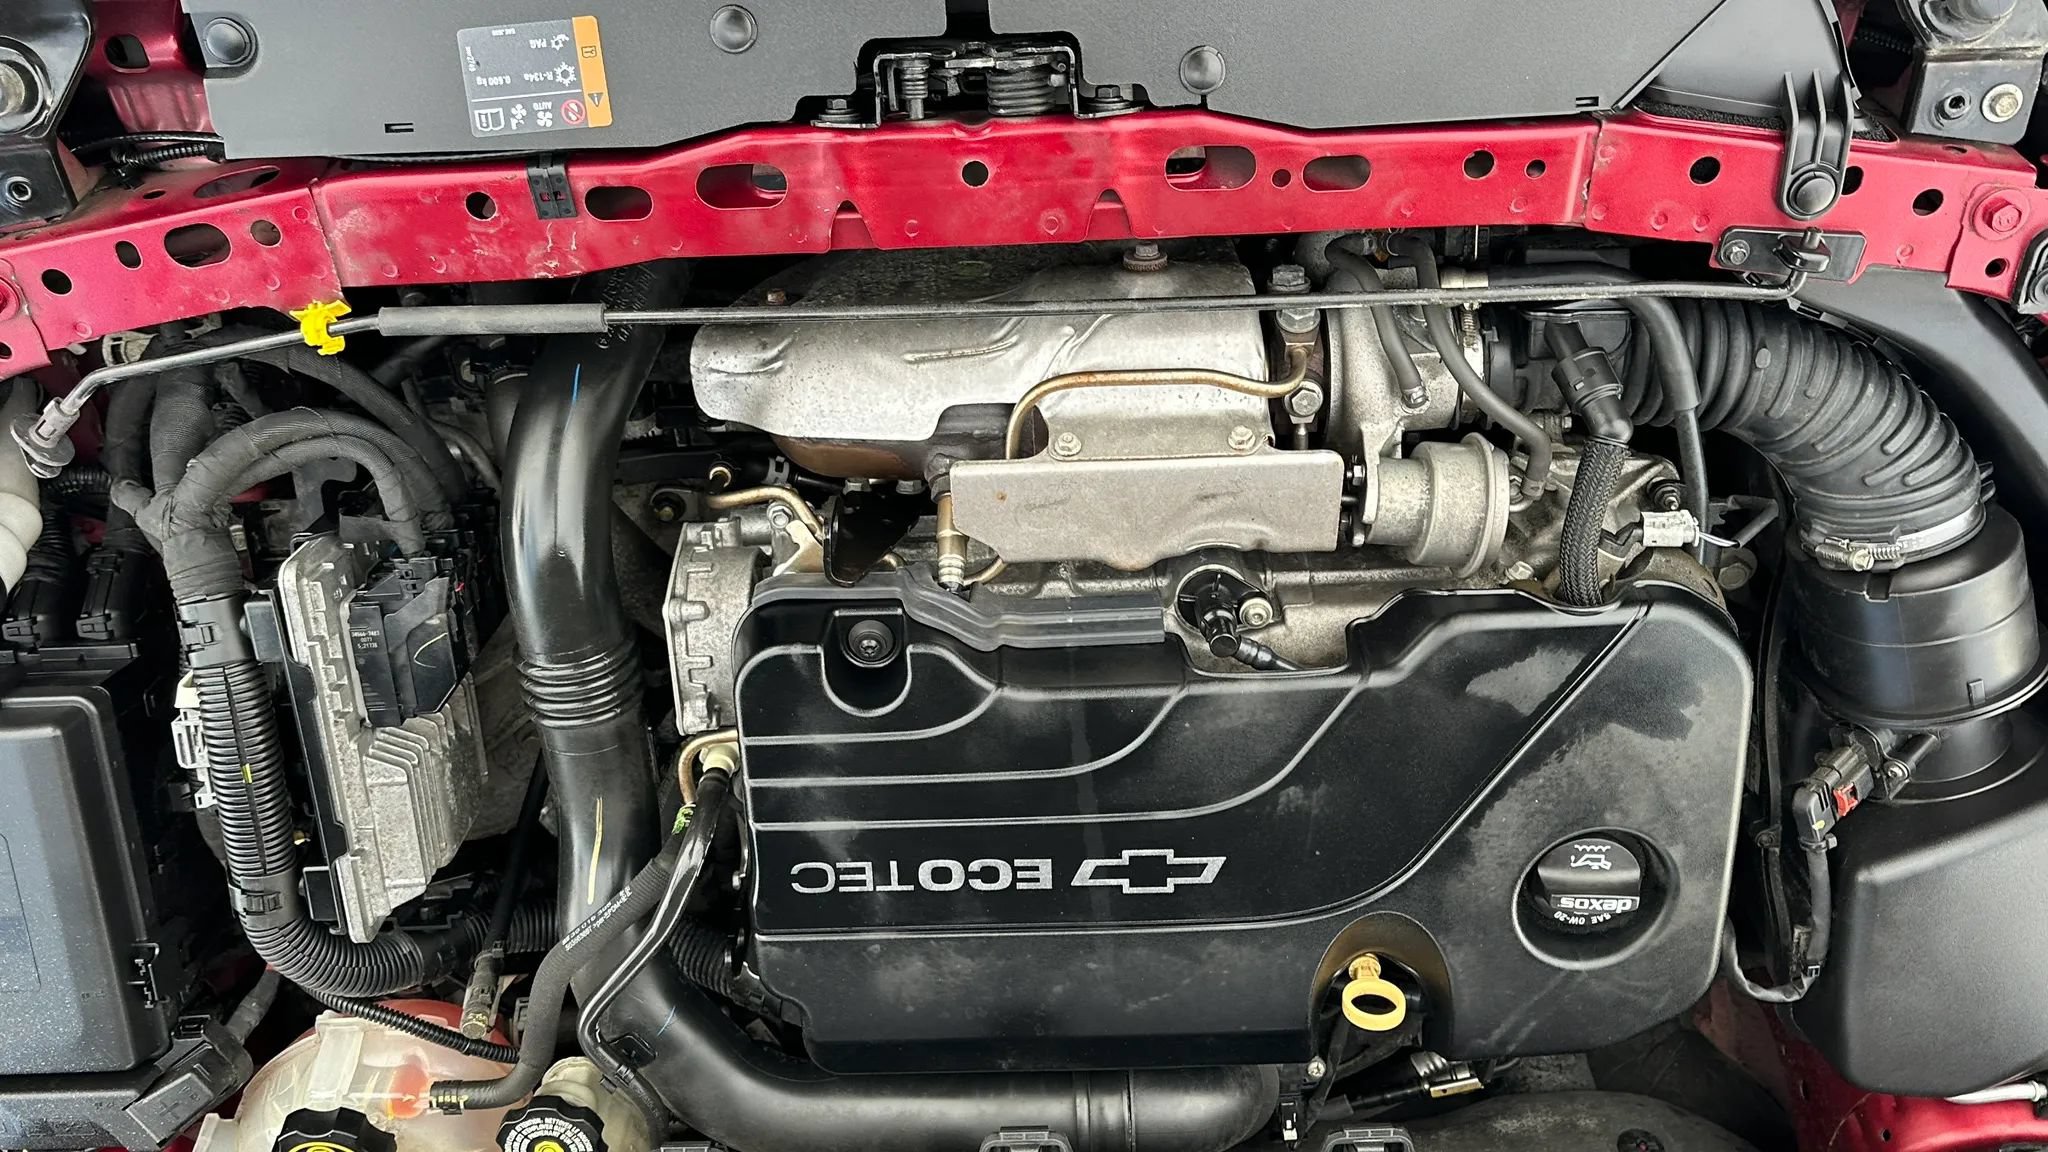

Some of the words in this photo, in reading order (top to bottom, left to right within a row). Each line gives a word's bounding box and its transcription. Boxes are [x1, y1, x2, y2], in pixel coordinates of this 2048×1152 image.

[529, 39, 547, 49] PAG
[523, 71, 554, 82] R-134a
[532, 101, 552, 110] AUTO
[789, 858, 1053, 894] ECOTEC
[1560, 897, 1632, 914] dexos
[1552, 910, 1586, 925] 0W-20
[1590, 912, 1612, 925] SAE
